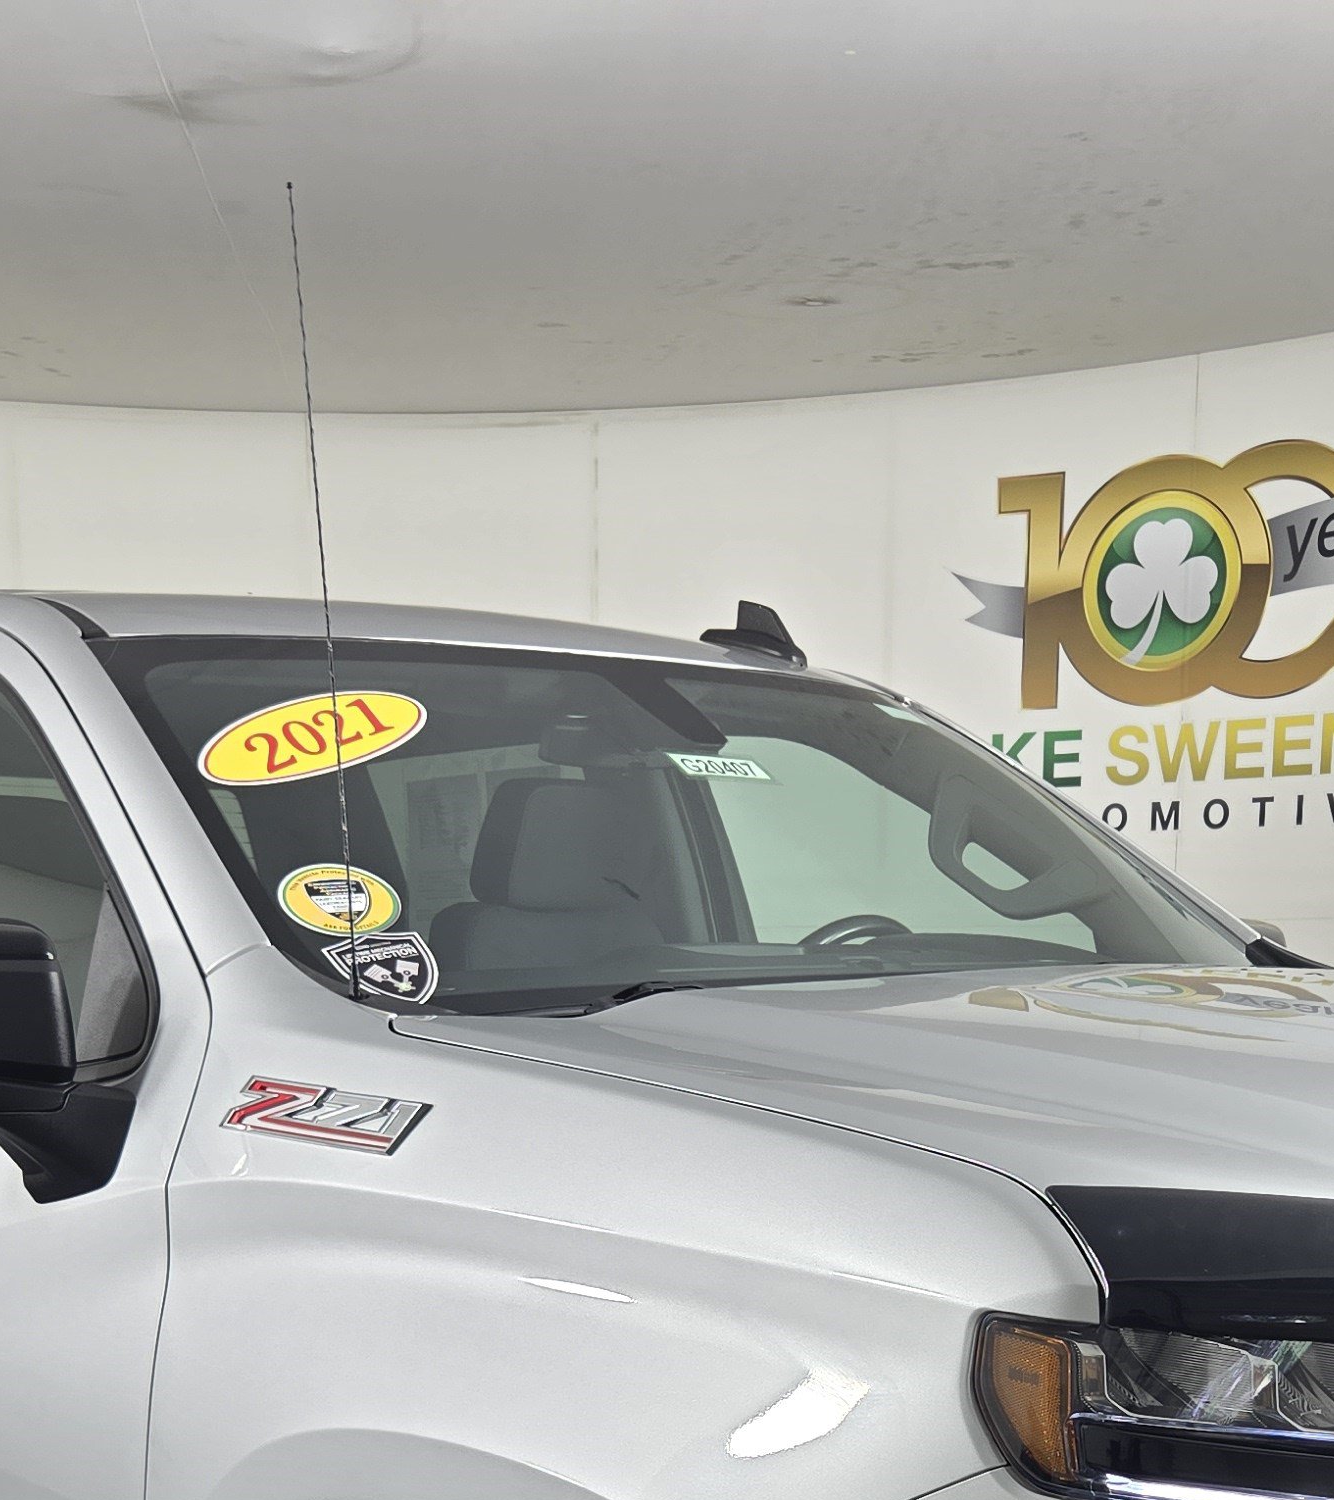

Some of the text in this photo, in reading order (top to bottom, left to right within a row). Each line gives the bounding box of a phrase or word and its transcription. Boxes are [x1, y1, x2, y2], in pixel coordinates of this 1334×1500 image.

[244, 699, 394, 773] 2021
[992, 729, 1083, 787] KE
[680, 758, 757, 777] G20407
[344, 947, 419, 966] PROTECTION
[219, 1075, 434, 1157] Z71
